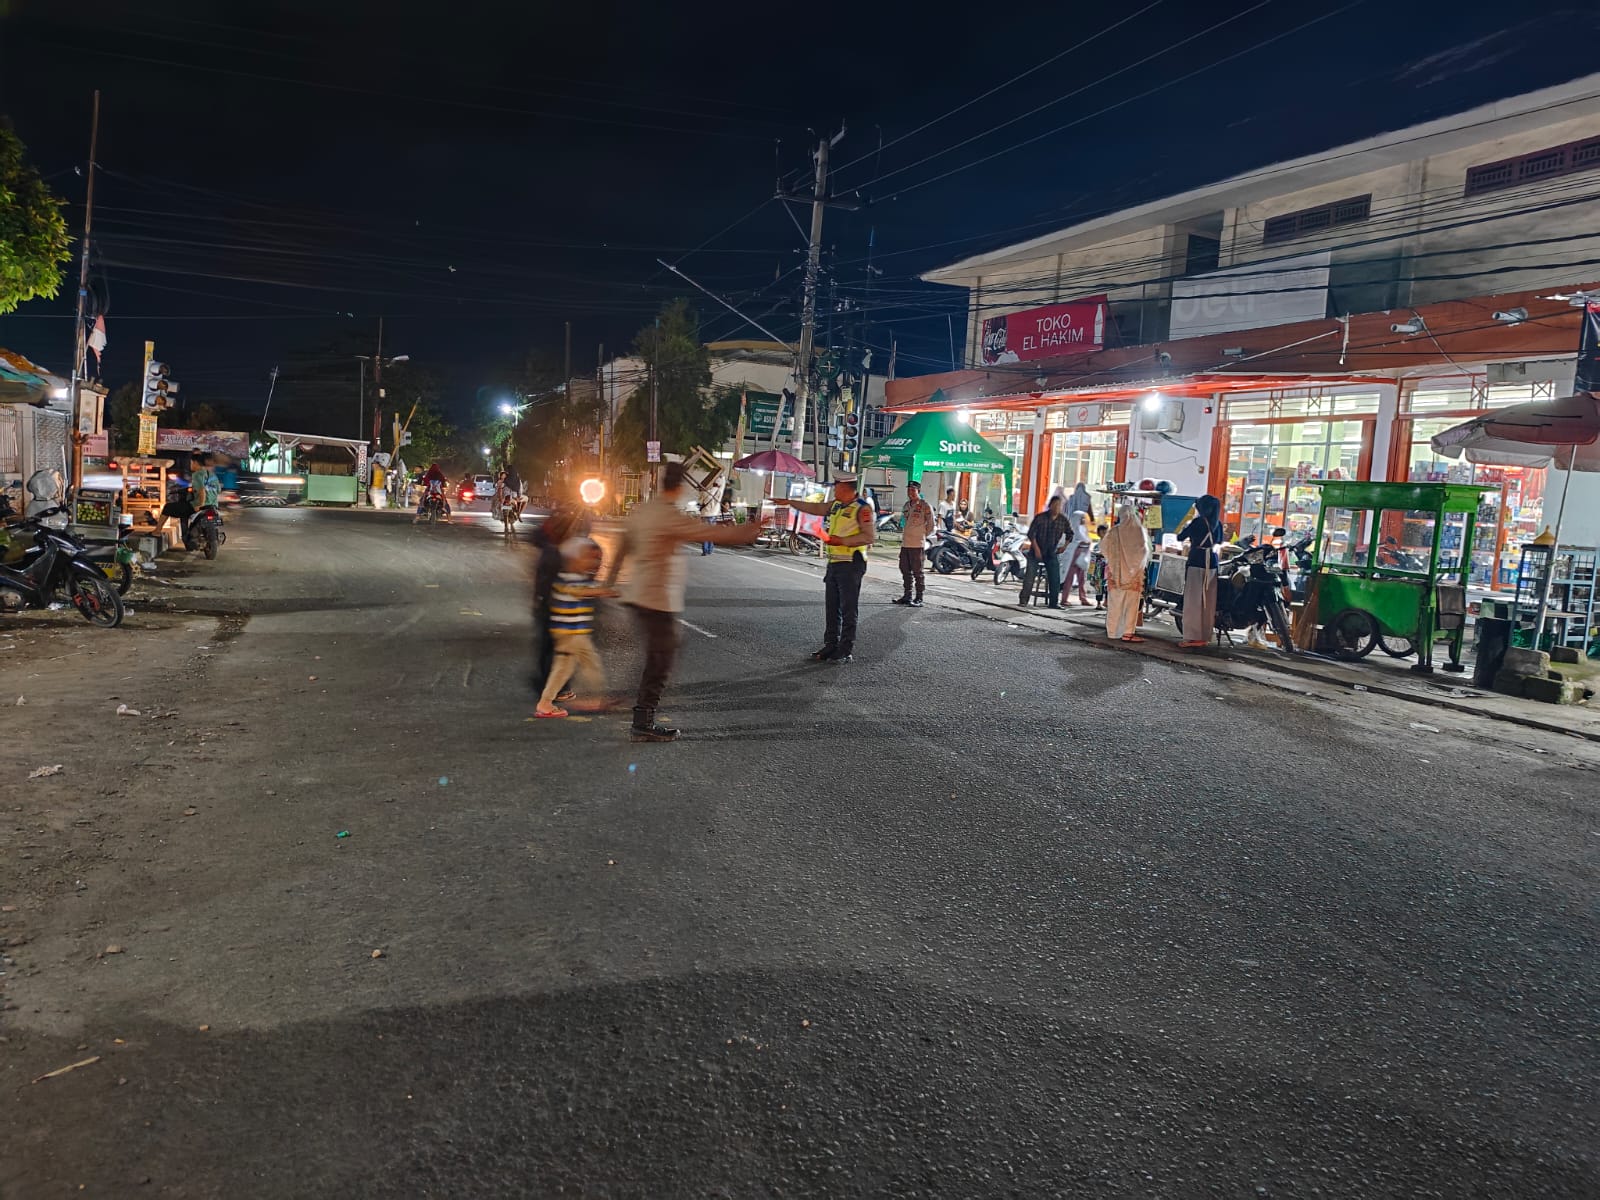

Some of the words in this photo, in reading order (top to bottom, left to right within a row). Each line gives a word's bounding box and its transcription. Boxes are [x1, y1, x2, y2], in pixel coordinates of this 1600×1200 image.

[1036, 313, 1071, 333] TOKO
[1023, 335, 1037, 351] EL
[1041, 327, 1084, 348] HAKIM
[939, 440, 982, 454] Sprite
